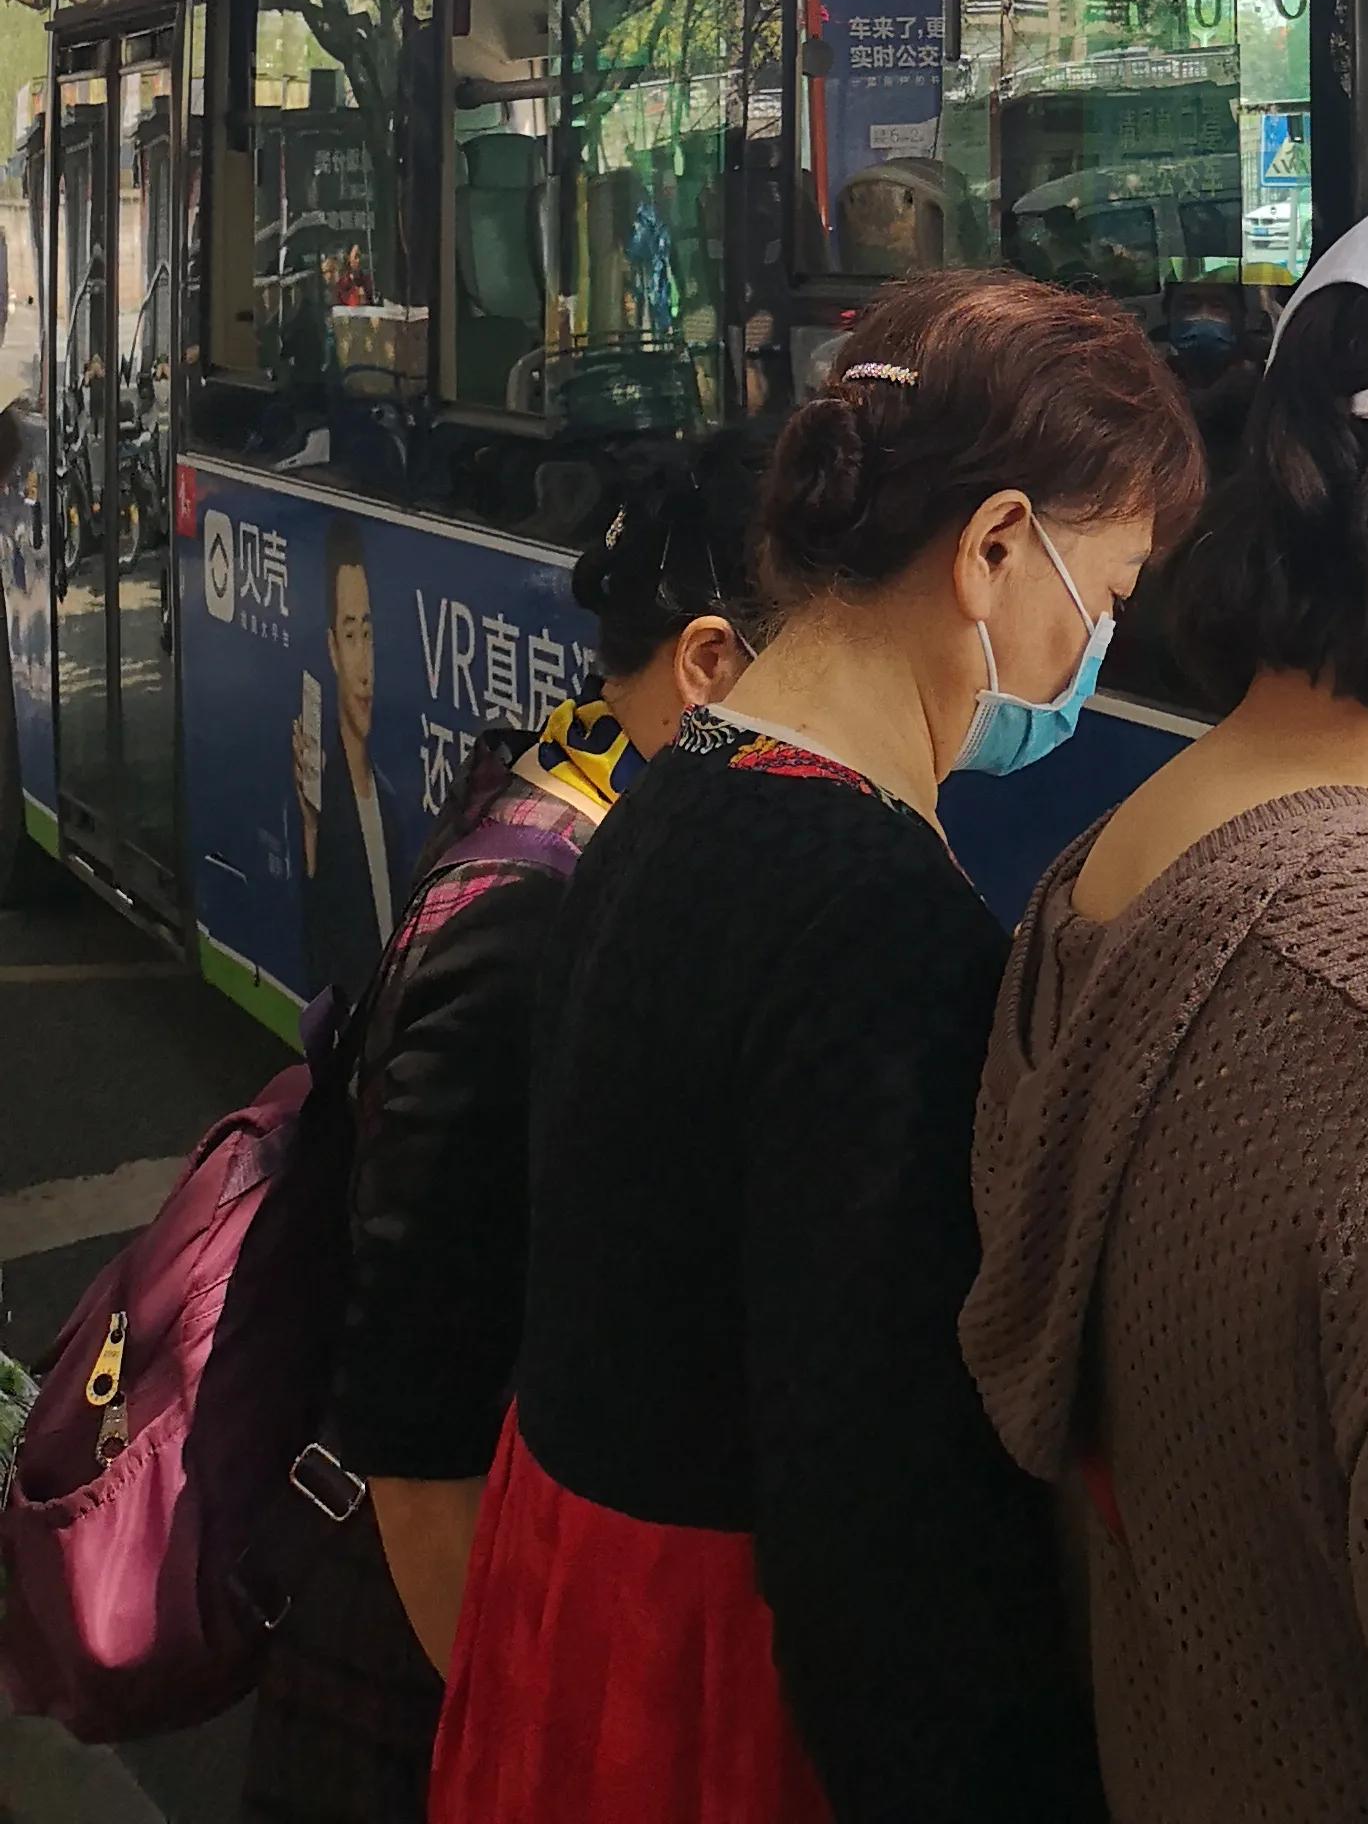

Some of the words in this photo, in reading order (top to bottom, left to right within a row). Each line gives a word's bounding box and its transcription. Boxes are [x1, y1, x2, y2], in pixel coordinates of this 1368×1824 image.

[850, 44, 940, 68] 实时公交
[239, 520, 290, 618] 贝壳
